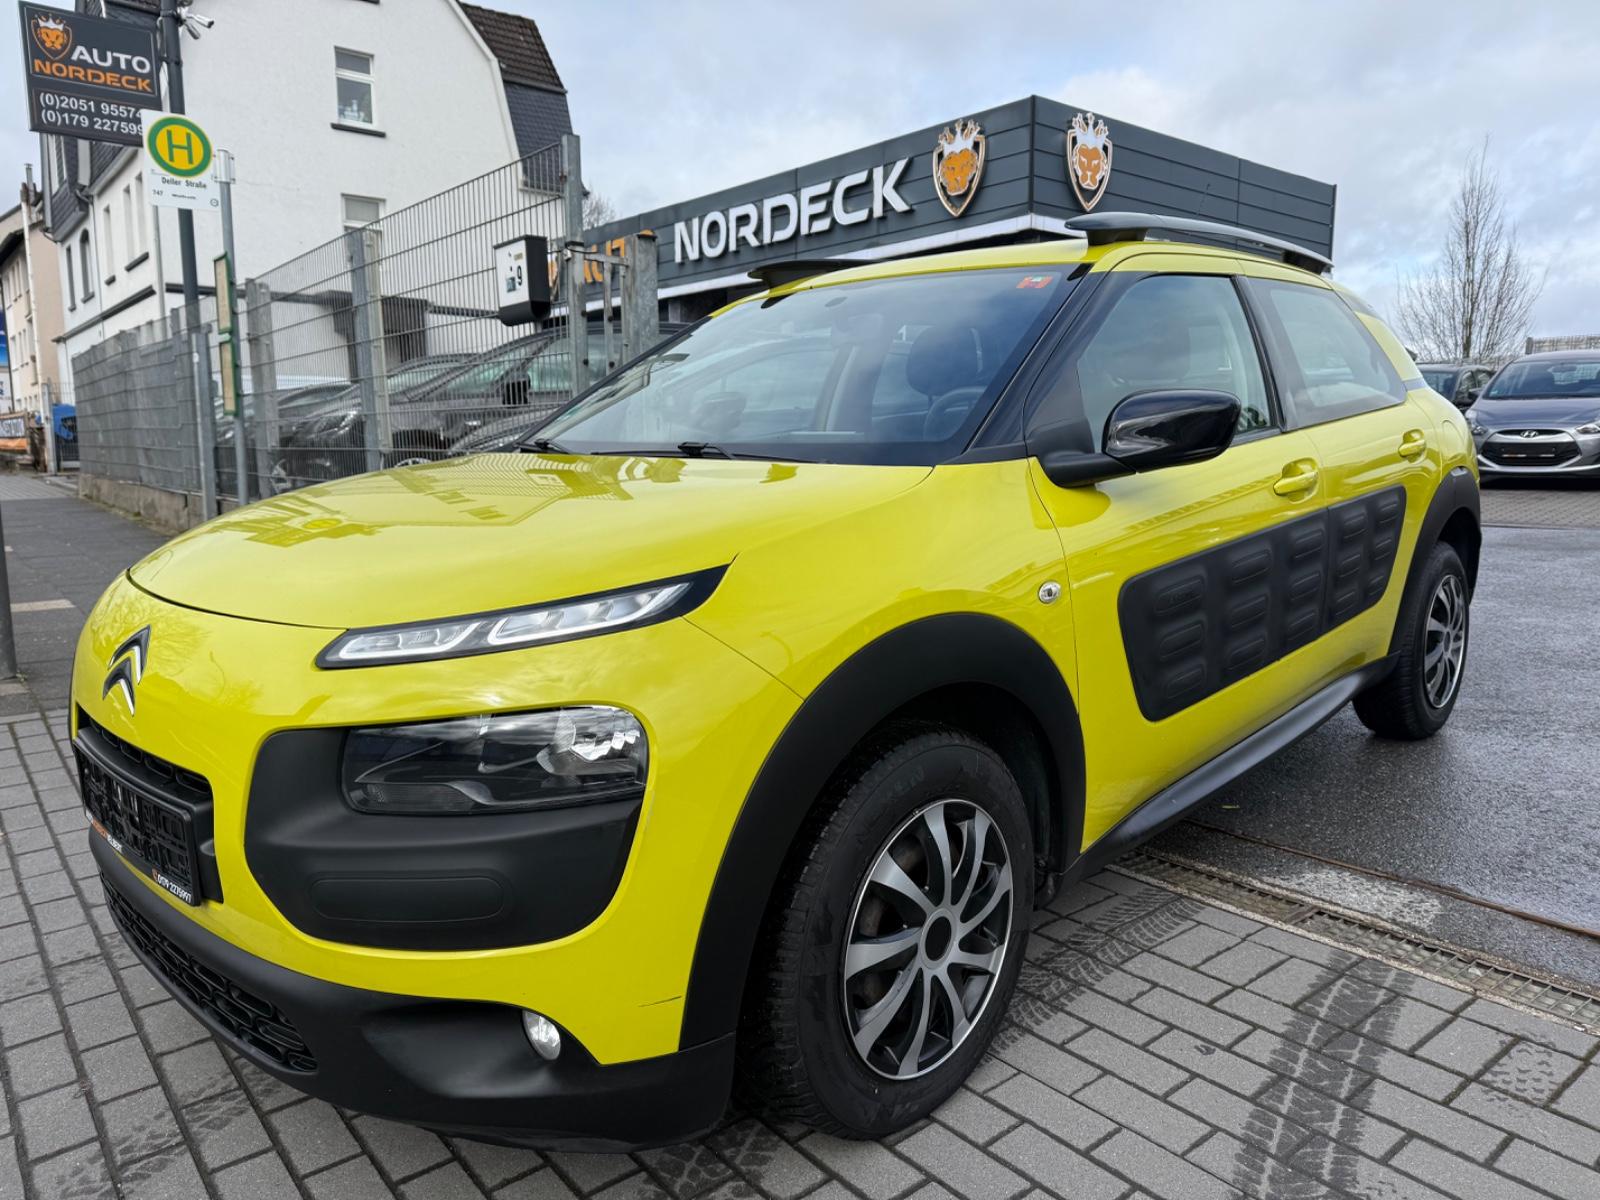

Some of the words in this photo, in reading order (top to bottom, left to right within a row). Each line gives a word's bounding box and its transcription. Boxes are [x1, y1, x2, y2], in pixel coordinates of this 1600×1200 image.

[71, 45, 151, 74] AUTO
[34, 59, 153, 93] NORDECK
[40, 92, 95, 113] (0)2051
[41, 109, 89, 128] (0)179
[166, 129, 194, 165] H
[674, 157, 911, 263] NORDECK
[517, 265, 522, 286] 9
